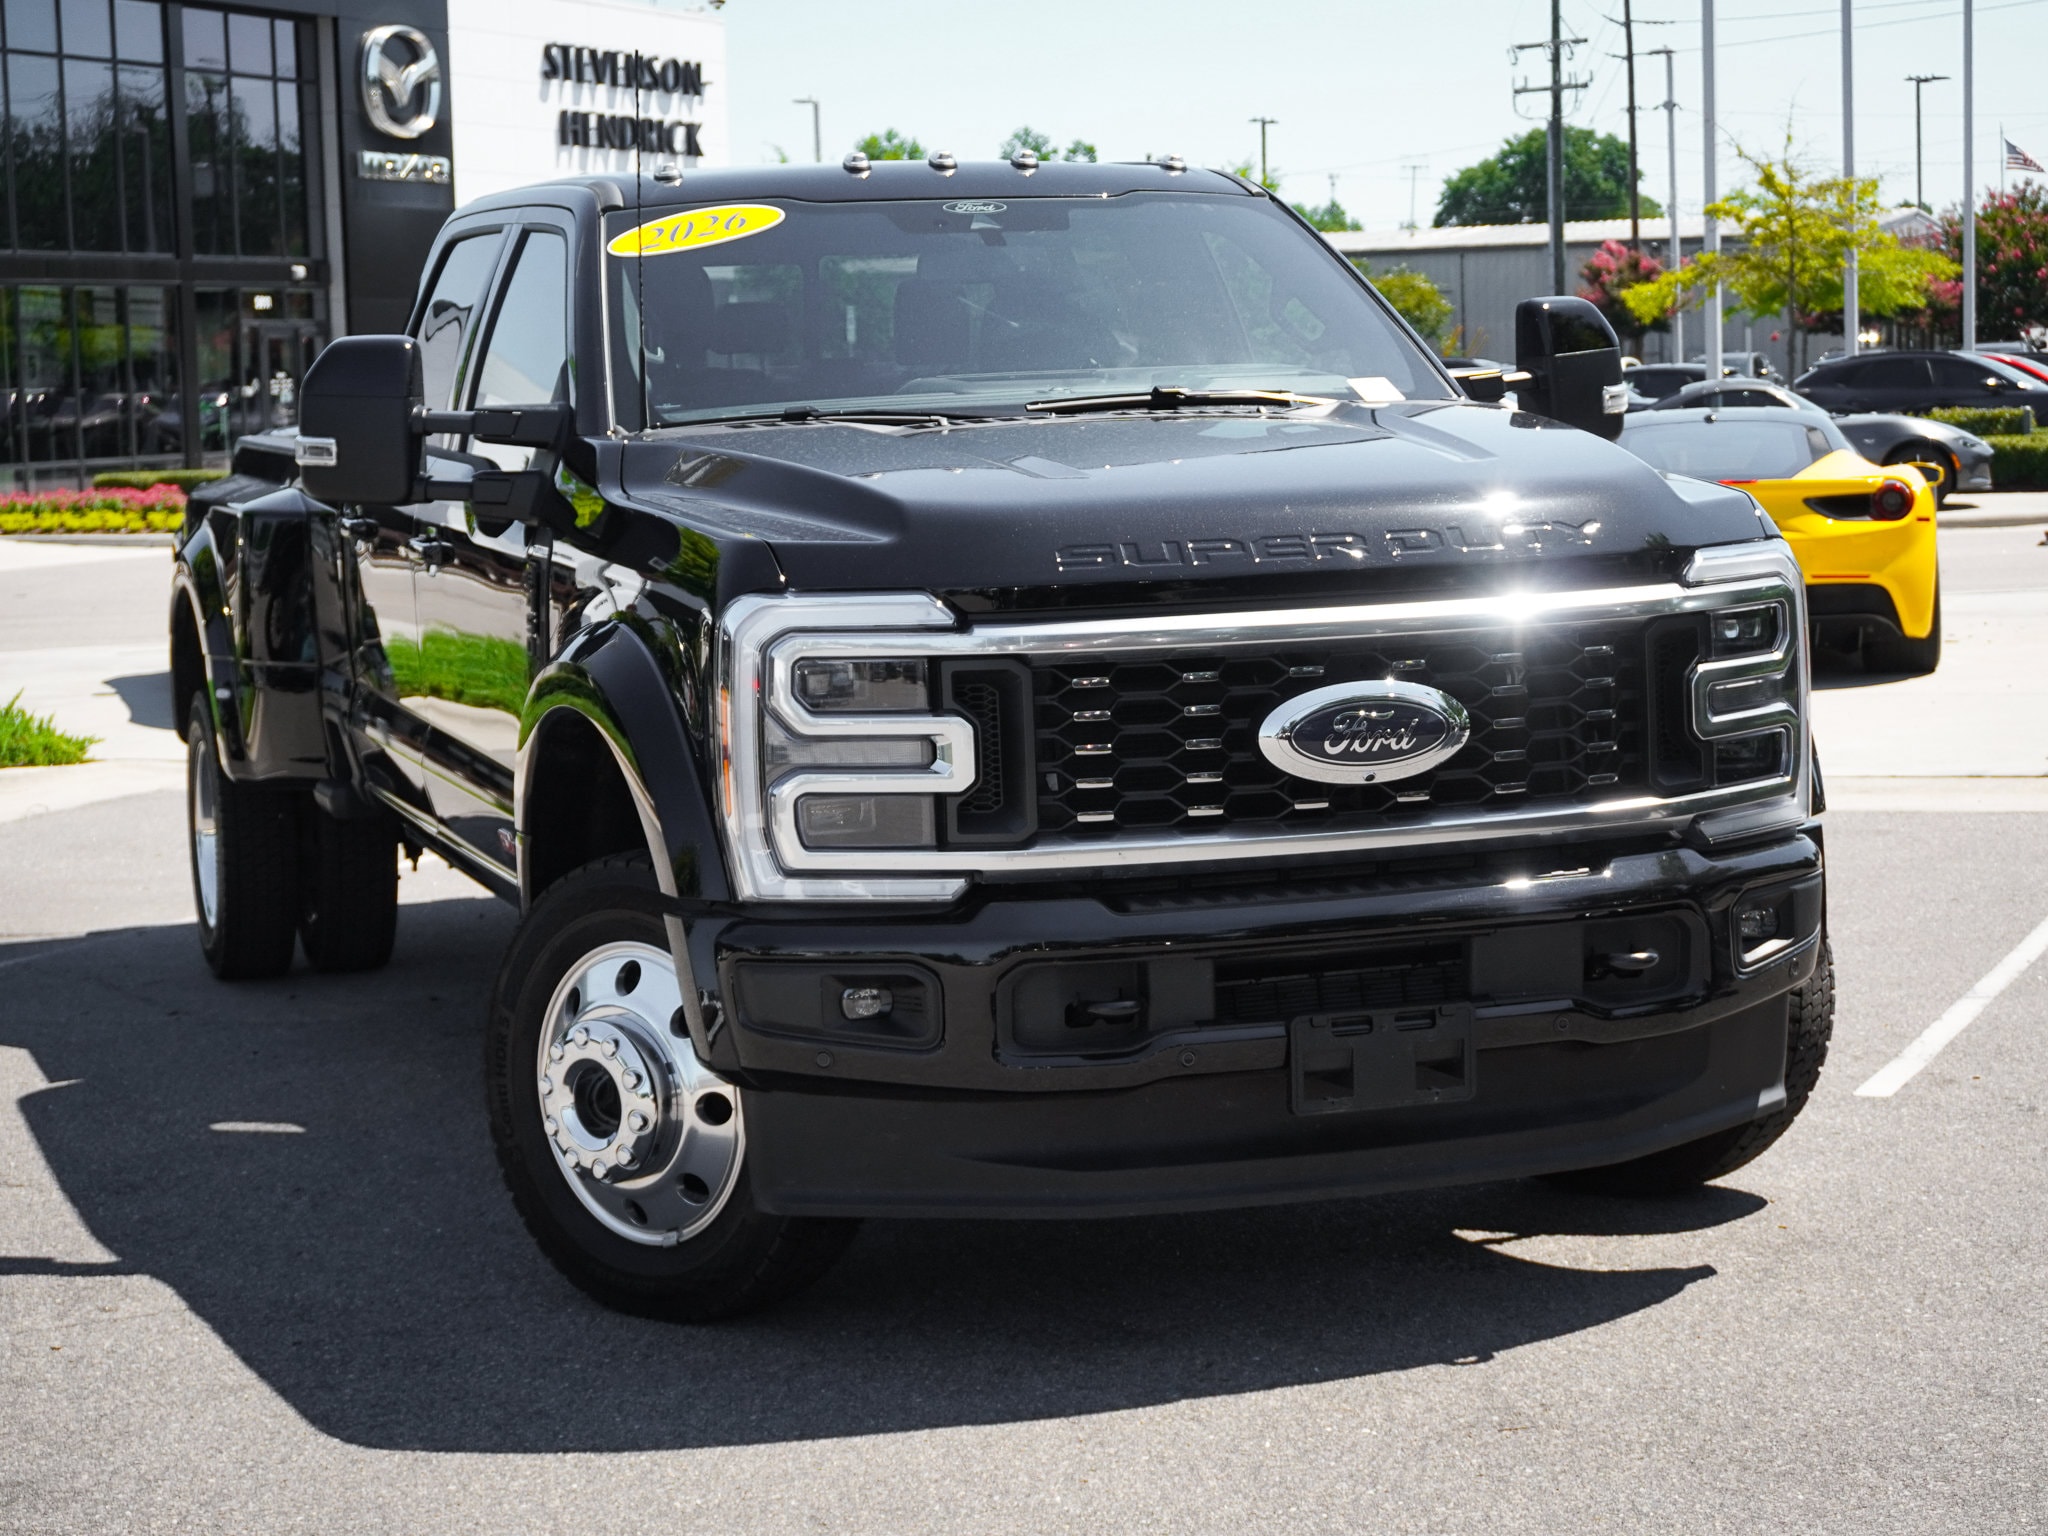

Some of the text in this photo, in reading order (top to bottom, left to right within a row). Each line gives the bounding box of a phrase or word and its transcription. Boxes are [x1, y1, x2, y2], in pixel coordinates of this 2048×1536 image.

[543, 43, 702, 95] STEVENSON
[559, 110, 703, 156] HENDRICK
[954, 202, 997, 212] Ford
[640, 211, 746, 250] 2026
[1056, 518, 1601, 571] SUPER DUTY
[1323, 709, 1420, 755] Ford
